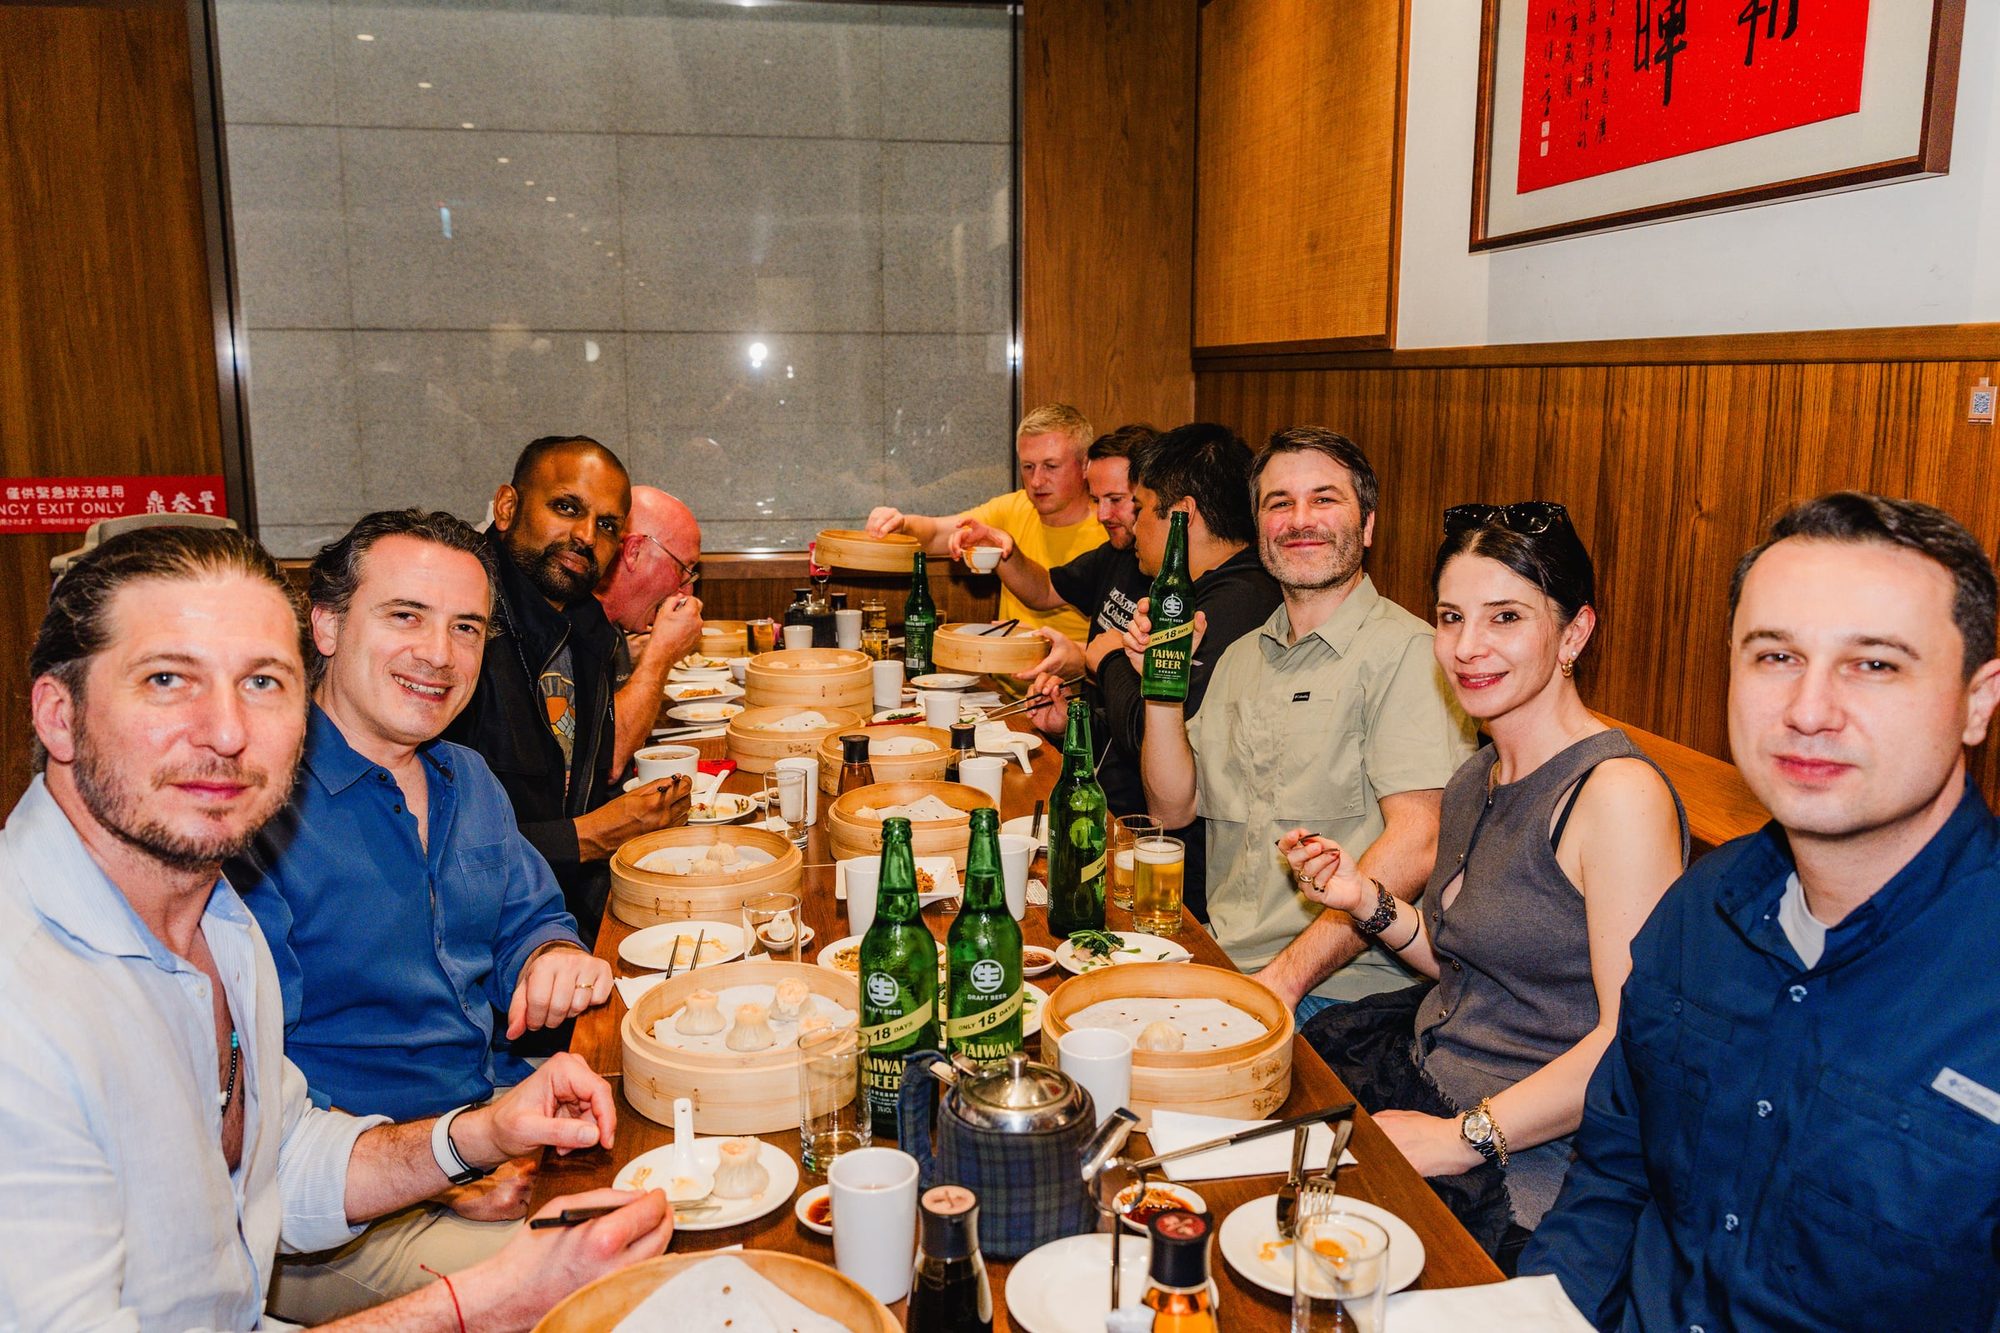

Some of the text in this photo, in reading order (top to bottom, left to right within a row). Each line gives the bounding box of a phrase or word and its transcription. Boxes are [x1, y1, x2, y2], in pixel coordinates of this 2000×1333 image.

[37, 502, 75, 515] EXIT
[81, 502, 125, 515] ONLY
[1164, 629, 1177, 640] 18
[1151, 648, 1186, 660] TAIWAN
[1155, 659, 1181, 669] BEER
[967, 993, 1008, 1001] DRAFT BEER
[883, 1008, 902, 1016] BEER
[958, 1002, 1016, 1031] ONLY 18 DAYS
[873, 1027, 891, 1041] 18
[893, 1021, 914, 1033] DAYS
[960, 1040, 1015, 1059] TAIWAN
